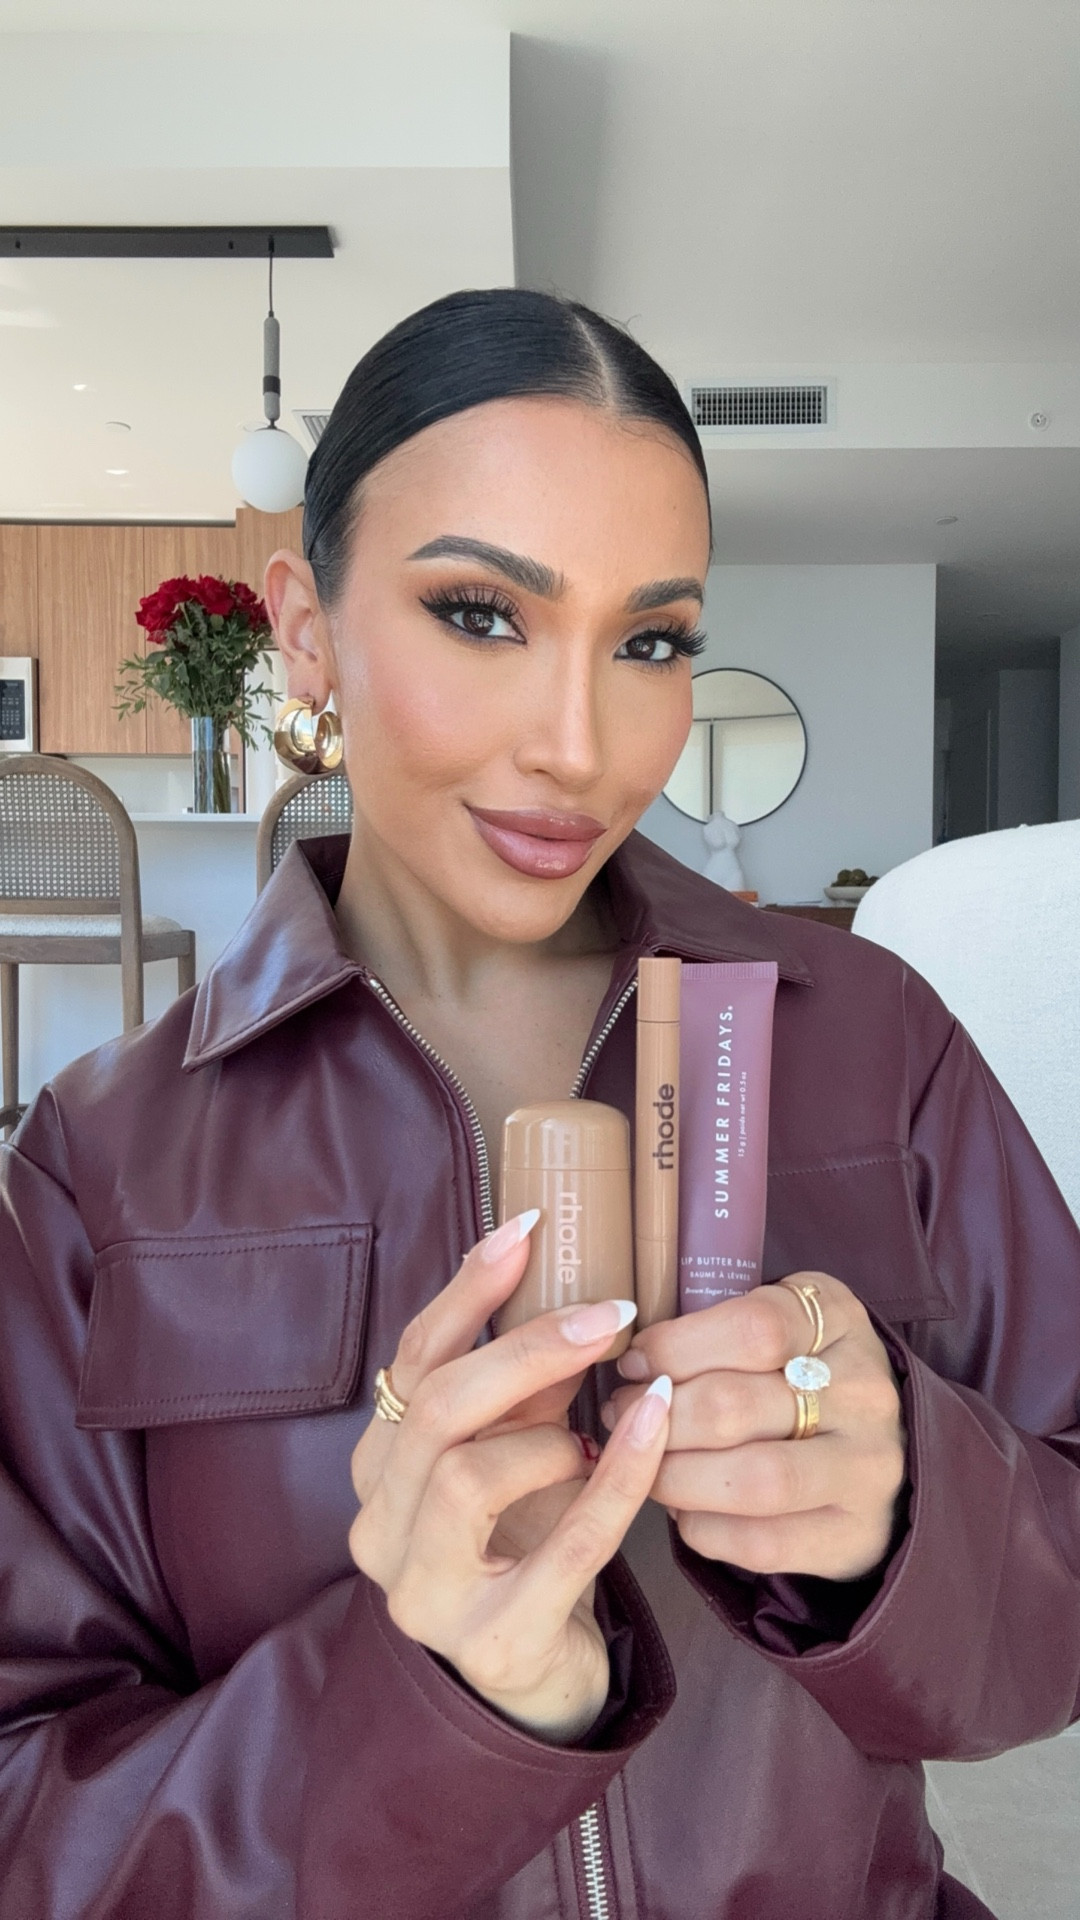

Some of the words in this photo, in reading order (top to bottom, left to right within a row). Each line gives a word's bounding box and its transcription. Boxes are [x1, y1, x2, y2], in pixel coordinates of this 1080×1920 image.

[717, 1005, 734, 1106] FRIDAYS.
[652, 1084, 674, 1170] rhode
[714, 1117, 730, 1219] SUMMER
[738, 1149, 745, 1157] 15
[558, 1191, 583, 1284] rhode
[681, 1257, 693, 1266] LIP
[697, 1257, 733, 1266] BUTTER
[737, 1259, 756, 1268] BALM
[704, 1287, 723, 1296] Sugar
